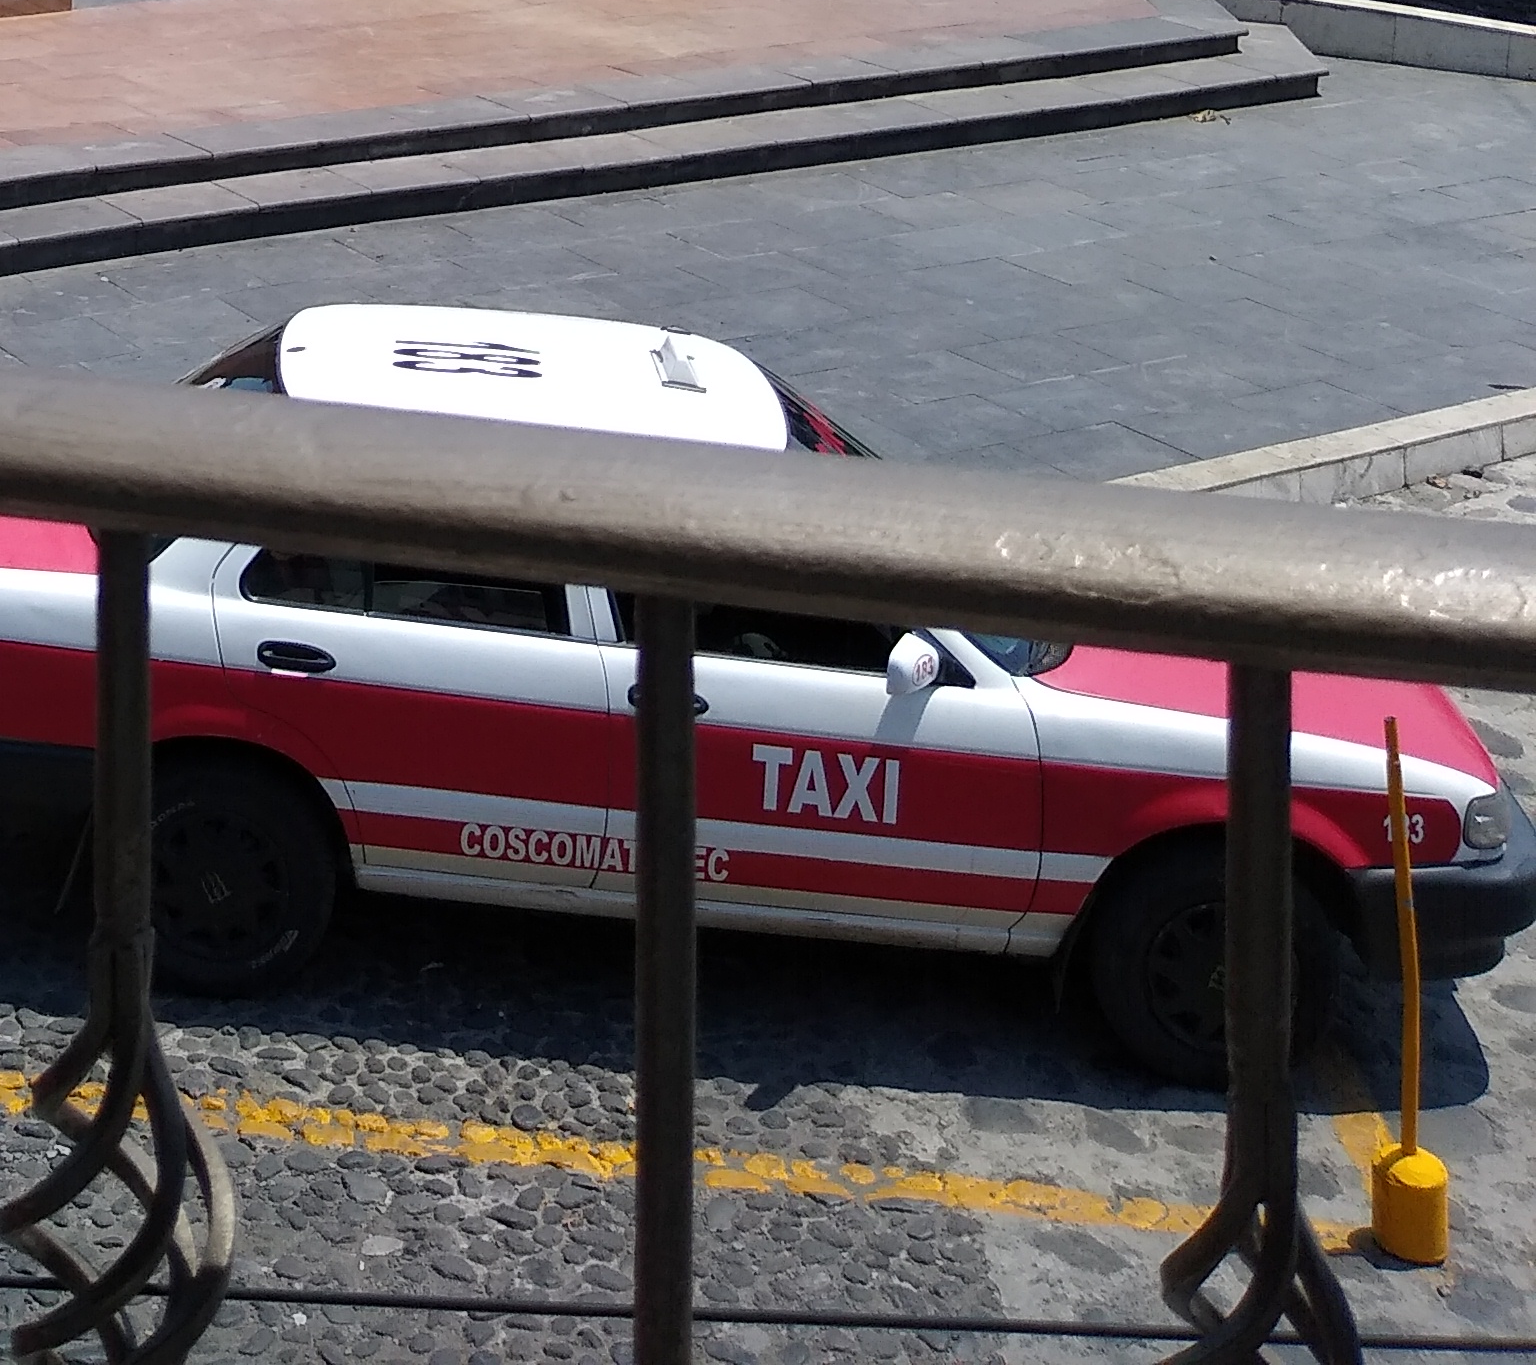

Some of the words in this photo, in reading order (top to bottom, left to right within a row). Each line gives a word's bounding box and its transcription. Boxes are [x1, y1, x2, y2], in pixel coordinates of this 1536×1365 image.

[752, 743, 900, 825] TAXI
[460, 822, 730, 881] COSCOMATEC
[1382, 813, 1425, 845] 13
